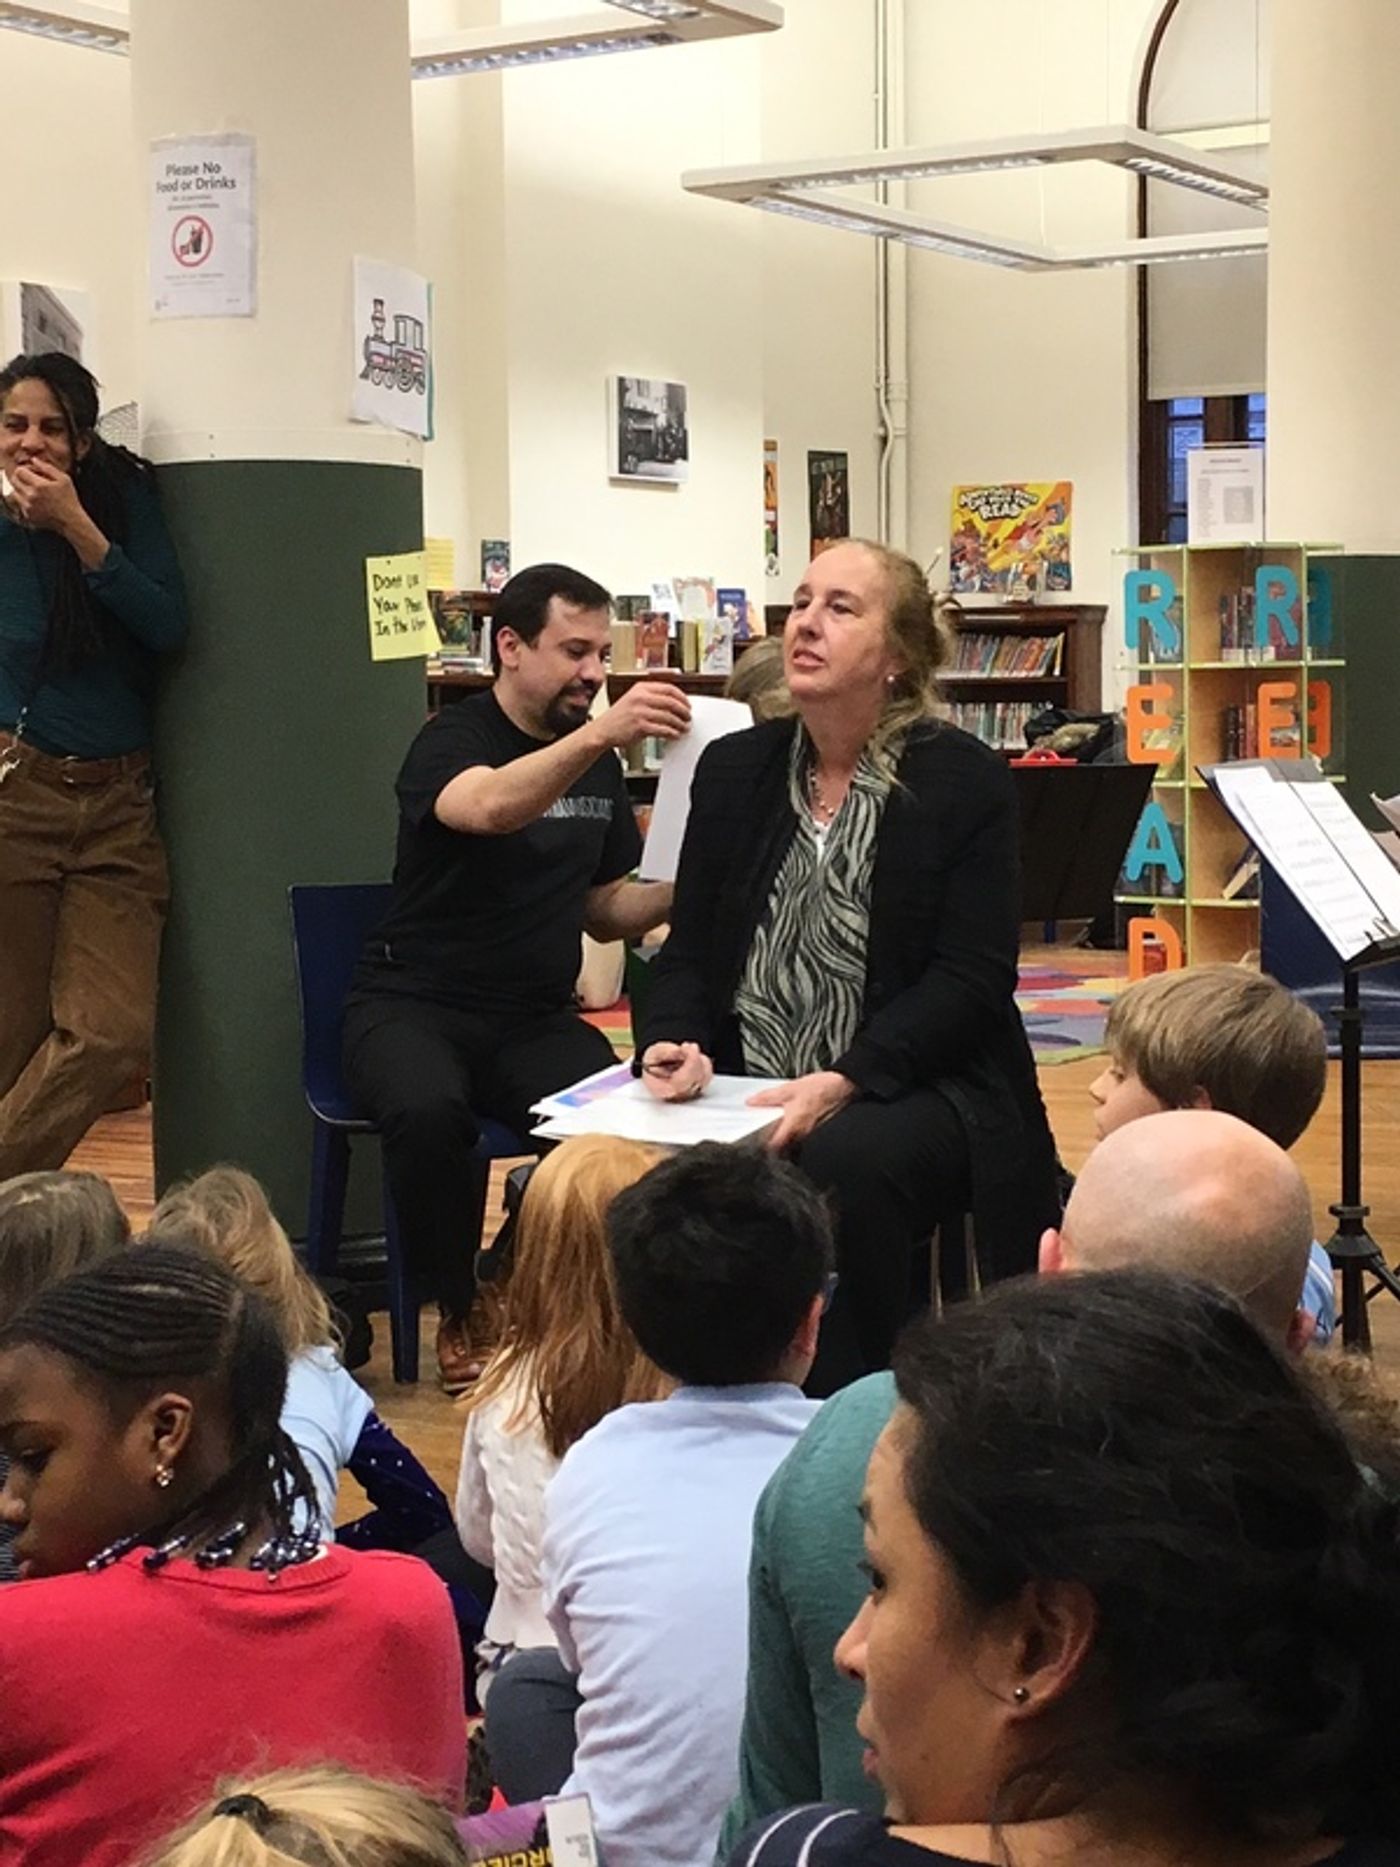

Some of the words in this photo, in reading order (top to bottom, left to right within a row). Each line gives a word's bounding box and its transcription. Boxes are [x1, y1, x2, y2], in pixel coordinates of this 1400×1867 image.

[166, 163, 199, 177] Please
[203, 162, 221, 175] No
[181, 180, 192, 192] or
[196, 175, 236, 190] Drinks
